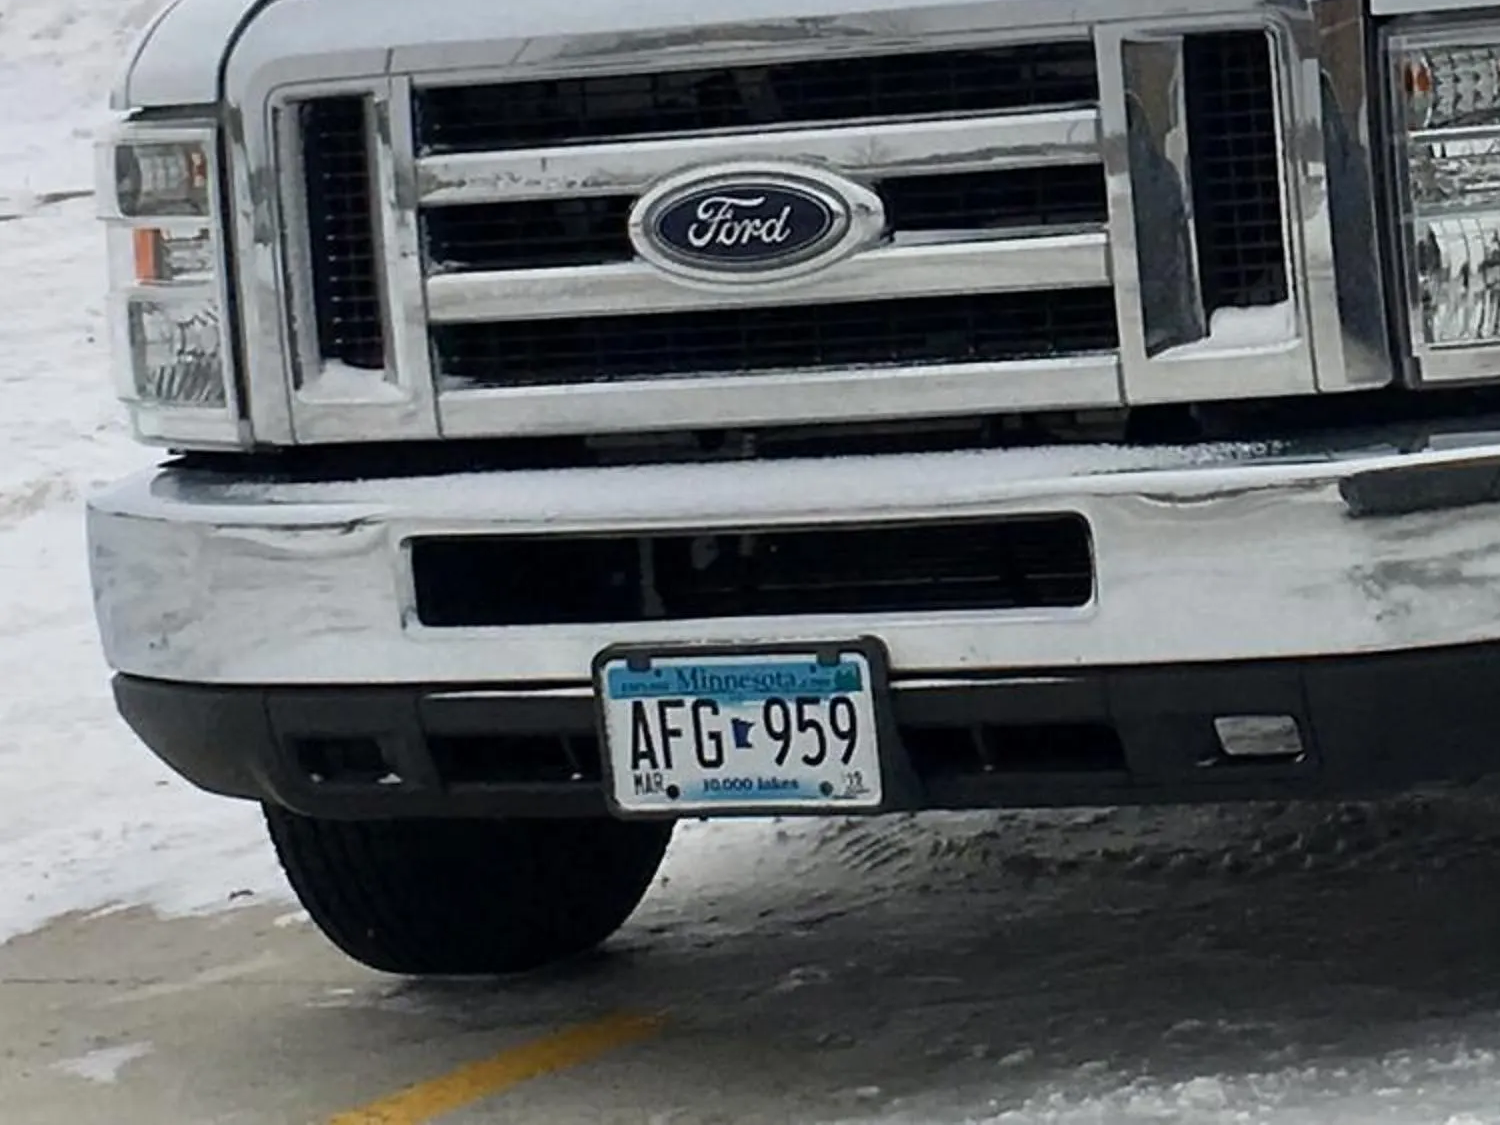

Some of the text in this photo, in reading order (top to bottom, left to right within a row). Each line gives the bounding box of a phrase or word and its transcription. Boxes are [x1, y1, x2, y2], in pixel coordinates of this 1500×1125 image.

[687, 195, 792, 248] Ford
[675, 666, 797, 692] Minnesota
[630, 695, 858, 771] AFG 959
[757, 776, 800, 791] lakes
